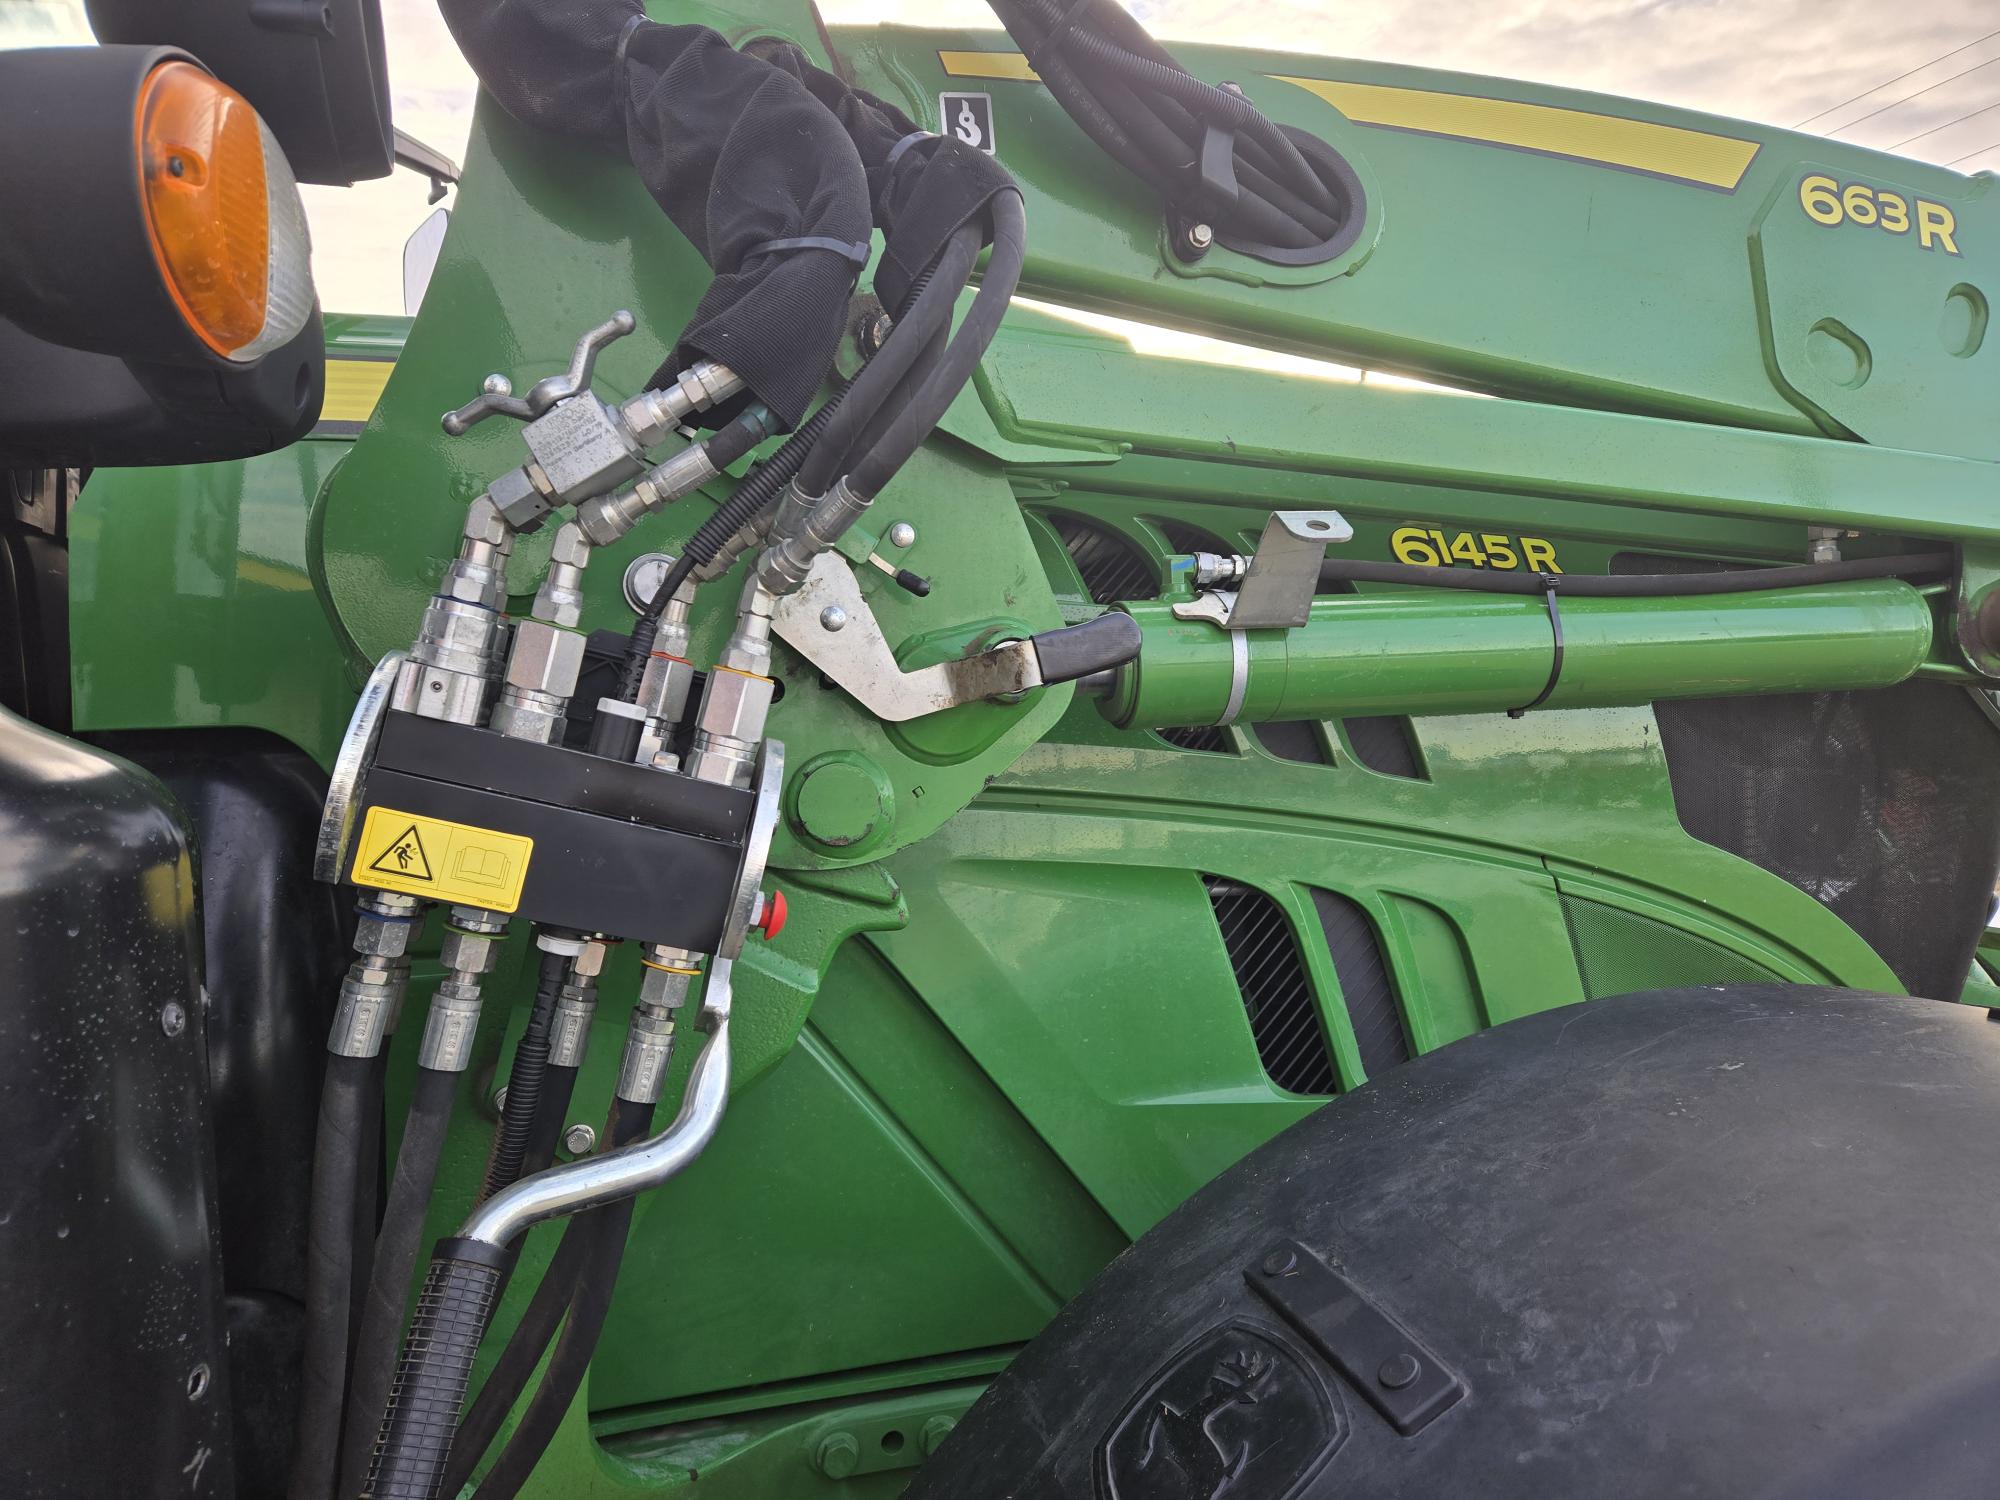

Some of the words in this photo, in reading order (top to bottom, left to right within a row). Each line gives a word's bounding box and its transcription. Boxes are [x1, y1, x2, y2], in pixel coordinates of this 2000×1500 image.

[1800, 174, 1910, 234] 663
[1916, 198, 1961, 255] R
[1391, 526, 1518, 569] 6145
[1519, 536, 1564, 574] R
